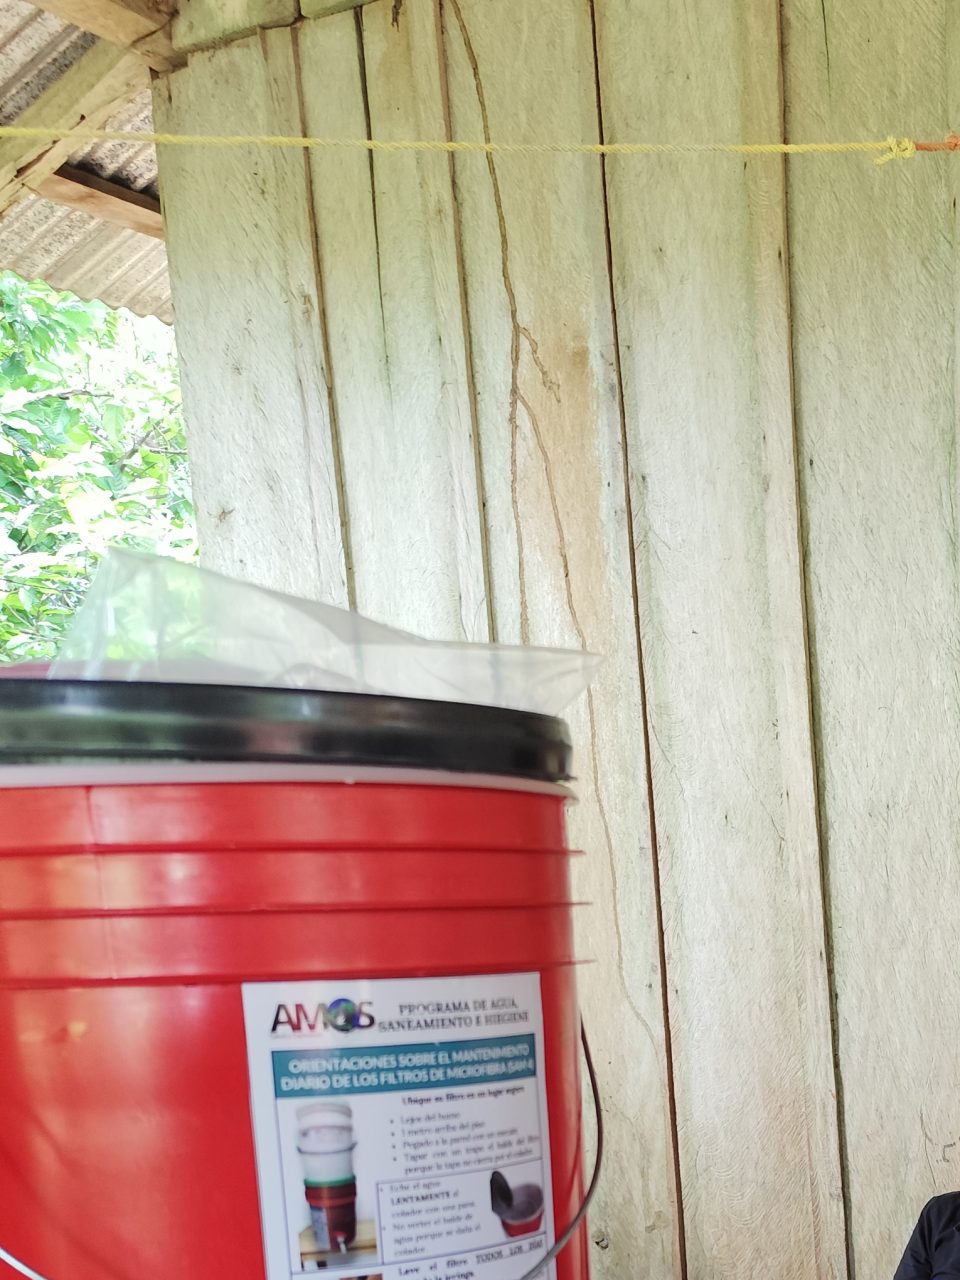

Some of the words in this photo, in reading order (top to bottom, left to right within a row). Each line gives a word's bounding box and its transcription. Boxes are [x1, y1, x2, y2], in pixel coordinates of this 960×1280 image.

[271, 998, 375, 1034] AMOS
[378, 1013, 473, 1033] SANEAMIENTO
[475, 1015, 481, 1026] E
[399, 1001, 470, 1017] PROGRAMA
[473, 999, 487, 1013] DE
[288, 1053, 397, 1074] ORIENTACIONES
[399, 1051, 437, 1068] SOBRE
[438, 1049, 451, 1064] EL
[451, 1043, 530, 1063] MANTENIMIENTO
[280, 1072, 330, 1091] DIARIO
[332, 1072, 351, 1089] DE
[353, 1071, 378, 1087] LOS
[380, 1068, 428, 1085] FILTROS
[430, 1067, 446, 1082] DE
[448, 1061, 507, 1081] MICROFIBRA
